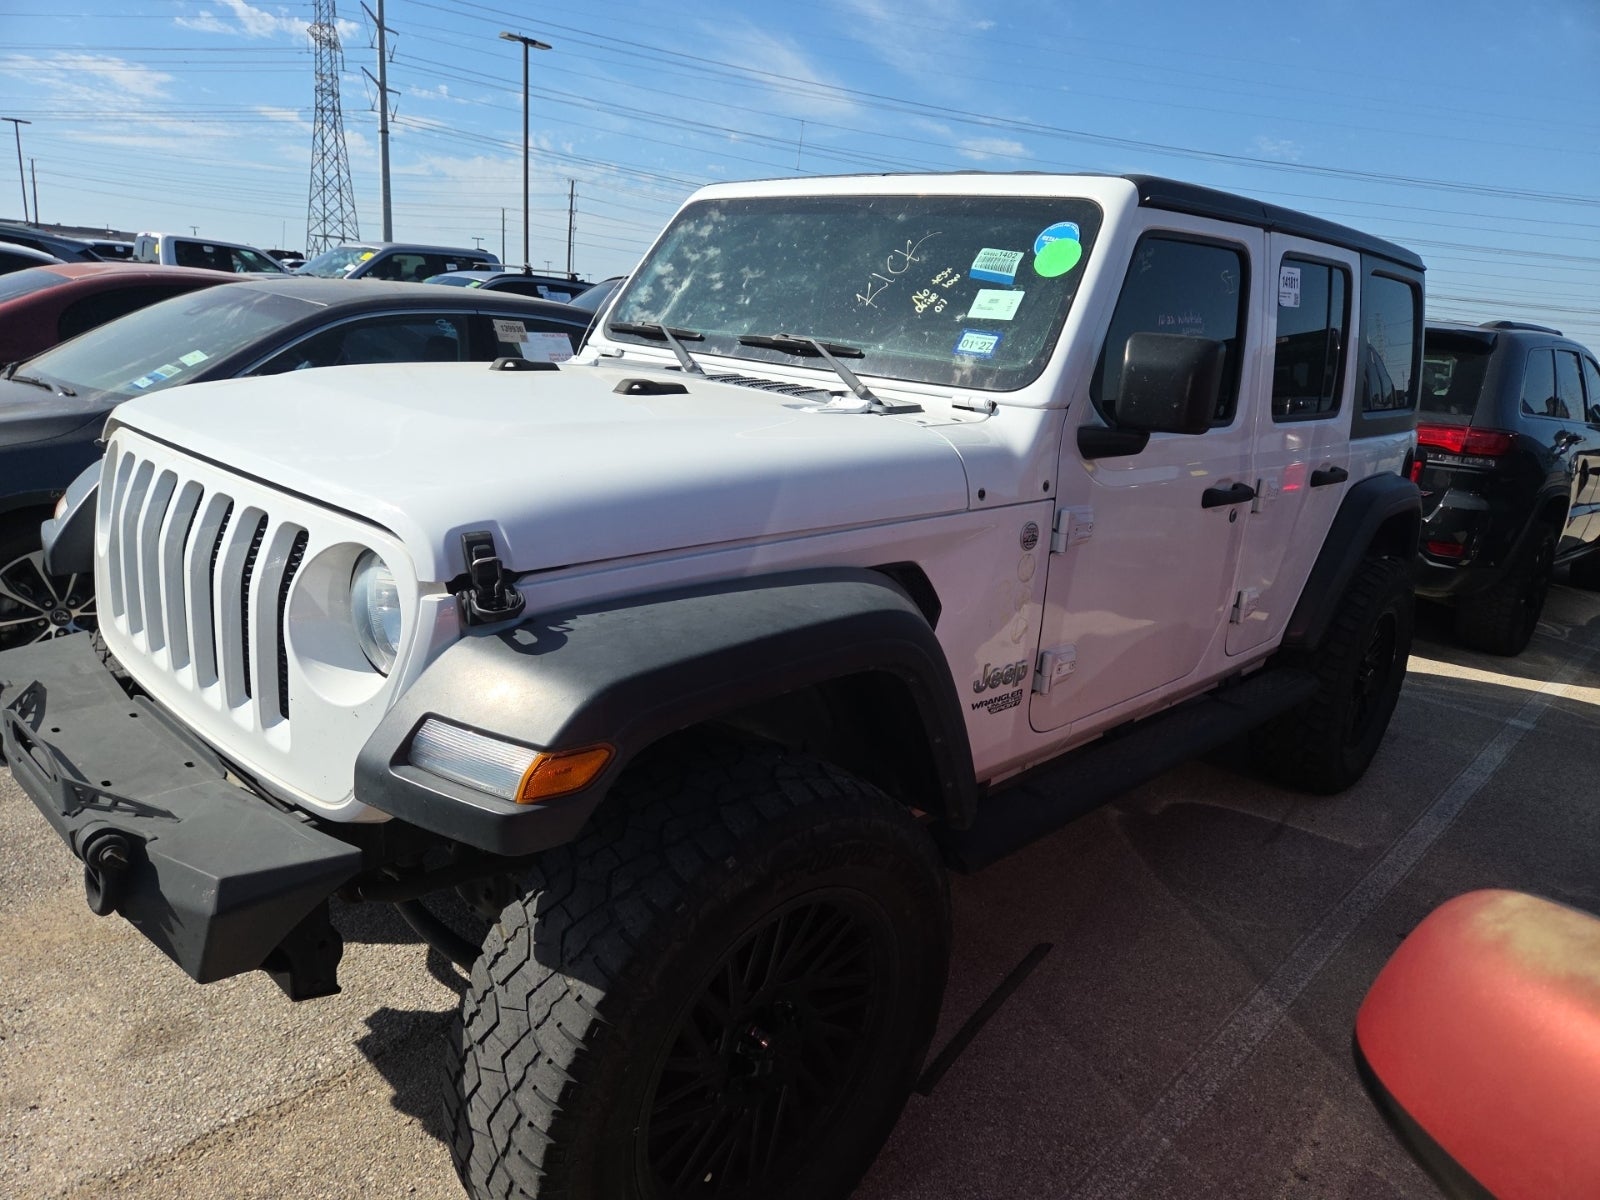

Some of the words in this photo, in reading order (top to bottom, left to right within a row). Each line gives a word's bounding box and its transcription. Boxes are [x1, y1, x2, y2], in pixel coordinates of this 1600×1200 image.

[912, 288, 930, 306] No
[931, 267, 952, 285] test
[914, 292, 939, 313] drive
[941, 273, 961, 288] low
[973, 660, 1028, 694] Jeep
[971, 689, 1023, 710] WRANGLER
